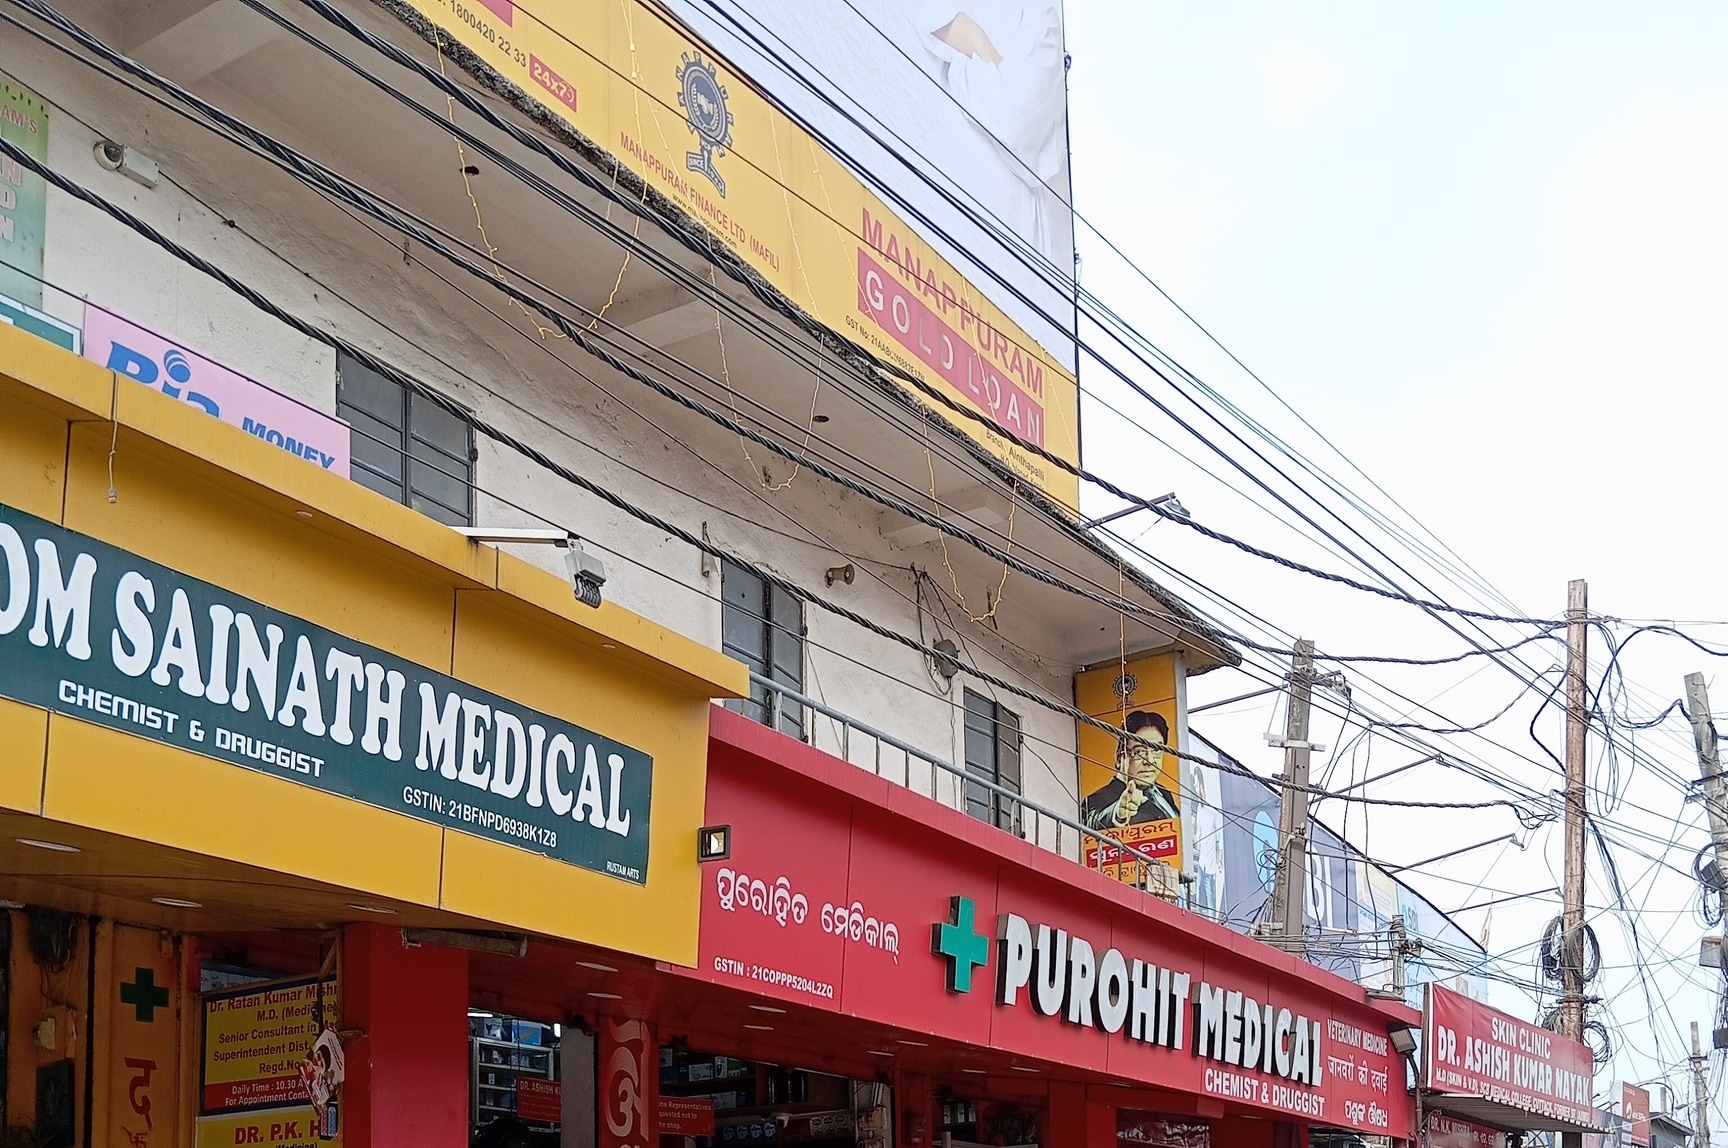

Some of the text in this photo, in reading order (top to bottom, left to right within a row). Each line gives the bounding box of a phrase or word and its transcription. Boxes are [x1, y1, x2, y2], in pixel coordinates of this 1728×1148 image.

[451, 0, 526, 67] 1800420 22 33
[621, 132, 780, 273] MANAPPURAM FINANCE LTD (MAFIL)
[862, 206, 1043, 399] MANAPPURAM
[846, 315, 858, 331] GST
[865, 269, 1041, 445] GOLD LOAN
[112, 571, 406, 761] SAINATH
[414, 682, 630, 837] MEDICAL
[59, 680, 325, 778] CHEMIST & DRUGGIST
[403, 786, 557, 848] GSTIN: 21BFNPD6938K1Z8
[607, 860, 640, 880] RUSTAM ARTS
[717, 867, 809, 927] ପୁରୋହିତ
[714, 956, 744, 976] GSTIN
[210, 1001, 224, 1013] Dr.
[228, 996, 260, 1010] Ratan
[264, 989, 302, 1005] Kumar
[256, 1011, 279, 1022] M.D.
[1001, 912, 1324, 1087] PUROHIT MEDICAL
[213, 1040, 311, 1062] Superintendent Dist.
[218, 1032, 249, 1044] Senior
[251, 1025, 304, 1039] Consultant
[307, 1022, 317, 1033] in
[1327, 1018, 1388, 1057] VETERINARY MEDICINE
[1491, 1016, 1551, 1060] SKIN CLINIC
[1357, 1060, 1369, 1086] की
[1370, 1065, 1388, 1096] दवाई
[1437, 1024, 1590, 1107] DR. ASHISH KUMAR NAYAK
[225, 1097, 236, 1106] For
[238, 1093, 287, 1106] Appointment
[232, 1084, 250, 1095] Daily
[252, 1082, 270, 1092] Time
[276, 1080, 296, 1090] 10.30
[531, 1082, 553, 1094] ASHISH
[1204, 1068, 1325, 1117] CHEMIST & DRUGGIST
[234, 1126, 264, 1145] DR.
[270, 1121, 303, 1141] P.K.
